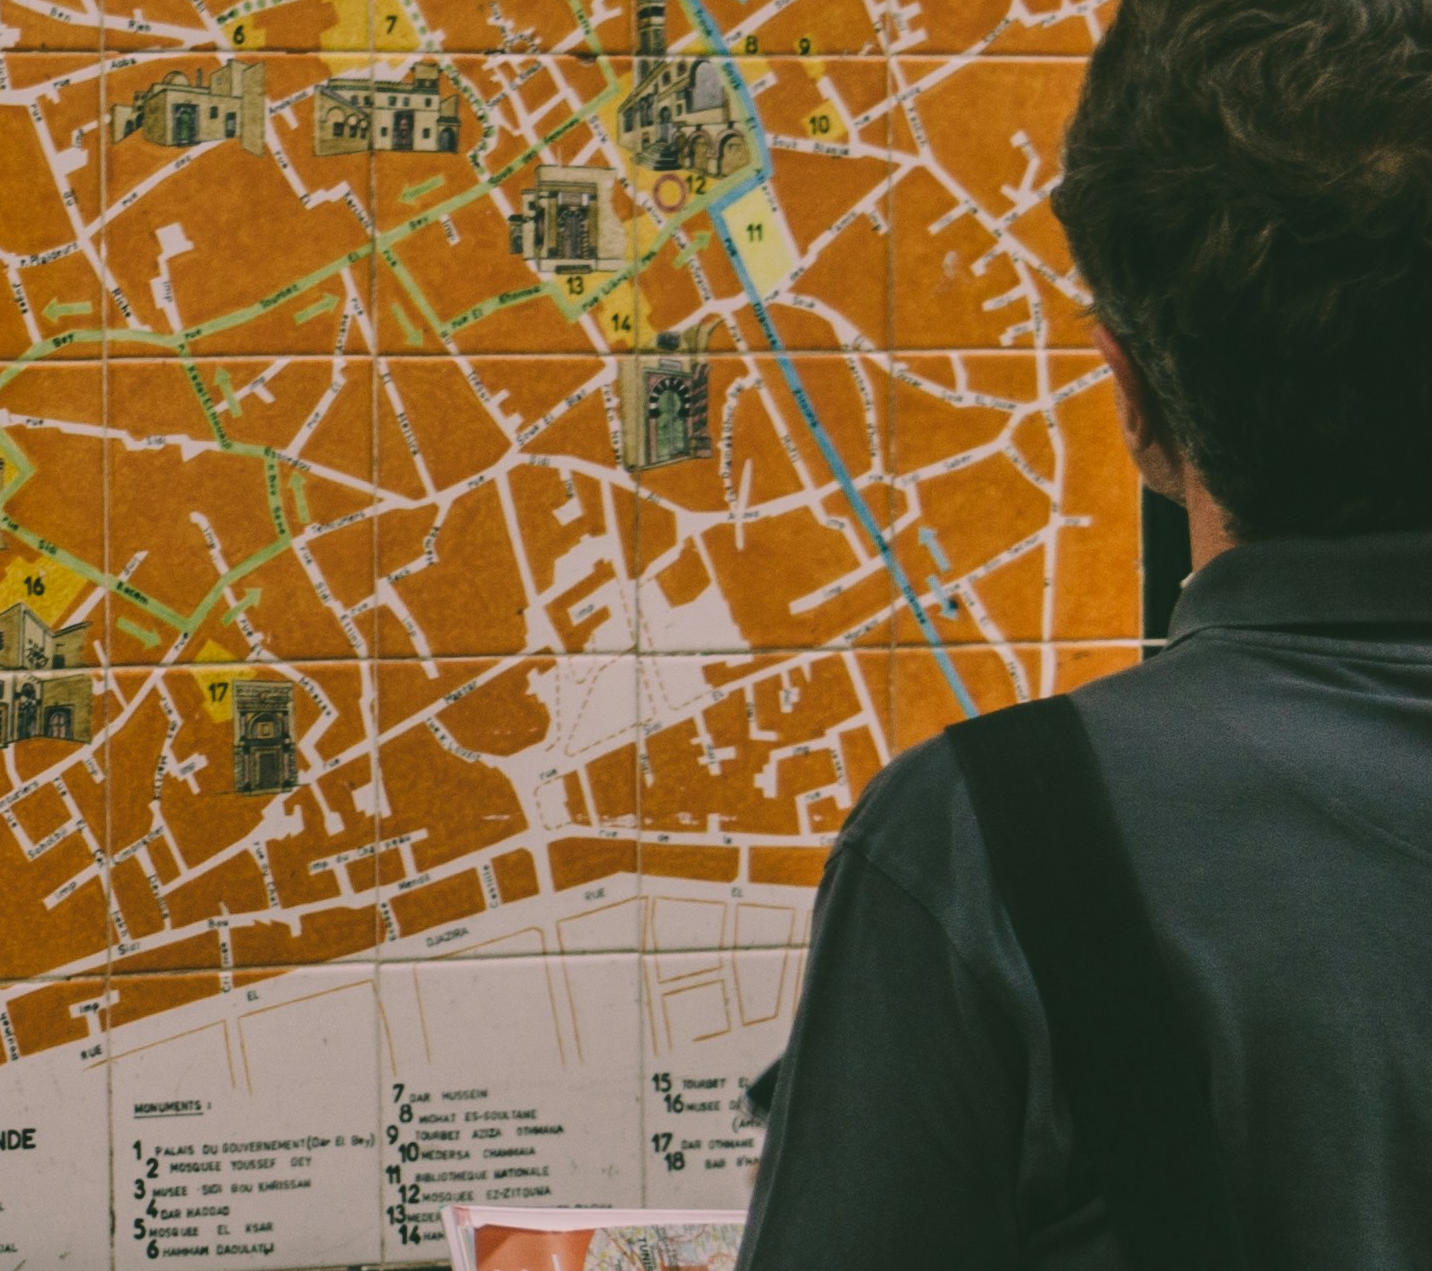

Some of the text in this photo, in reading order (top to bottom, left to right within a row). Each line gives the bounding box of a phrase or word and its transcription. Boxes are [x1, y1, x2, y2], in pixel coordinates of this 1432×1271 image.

[233, 25, 246, 45] 6
[385, 15, 397, 35] 7
[745, 35, 758, 54] 8
[798, 38, 811, 55] 9
[809, 114, 830, 135] 10
[686, 175, 706, 195] 12
[746, 223, 763, 243] 11
[567, 276, 584, 296] 13
[612, 313, 632, 333] 14
[24, 576, 45, 597] 16
[208, 683, 228, 703] 17
[652, 1073, 672, 1092] 15
[393, 1084, 488, 1104] 7 DAR HUSSEIN
[664, 1094, 684, 1113] 16
[399, 1104, 413, 1124] 8
[386, 1125, 399, 1145] 9
[652, 1133, 673, 1152] 17
[133, 1140, 142, 1160] 1
[155, 1145, 195, 1157] PALAIS
[202, 1144, 218, 1154] DU
[398, 1142, 419, 1163] 10
[146, 1158, 159, 1179] 2
[170, 1161, 222, 1174] MOSQUEE
[230, 1158, 277, 1171] YOUSSEF
[664, 1152, 685, 1171] 18
[385, 1165, 401, 1184] 11
[133, 1179, 146, 1200] 3
[152, 1186, 188, 1198] MUSEE
[398, 1184, 420, 1204] 12
[146, 1199, 159, 1219] 4
[161, 1209, 181, 1220] DAR
[386, 1206, 406, 1225] 13
[133, 1218, 146, 1239] 5
[149, 1227, 199, 1238] MOSQUEE
[218, 1225, 230, 1236] EL
[398, 1225, 421, 1245] 14
[146, 1240, 159, 1259] 6
